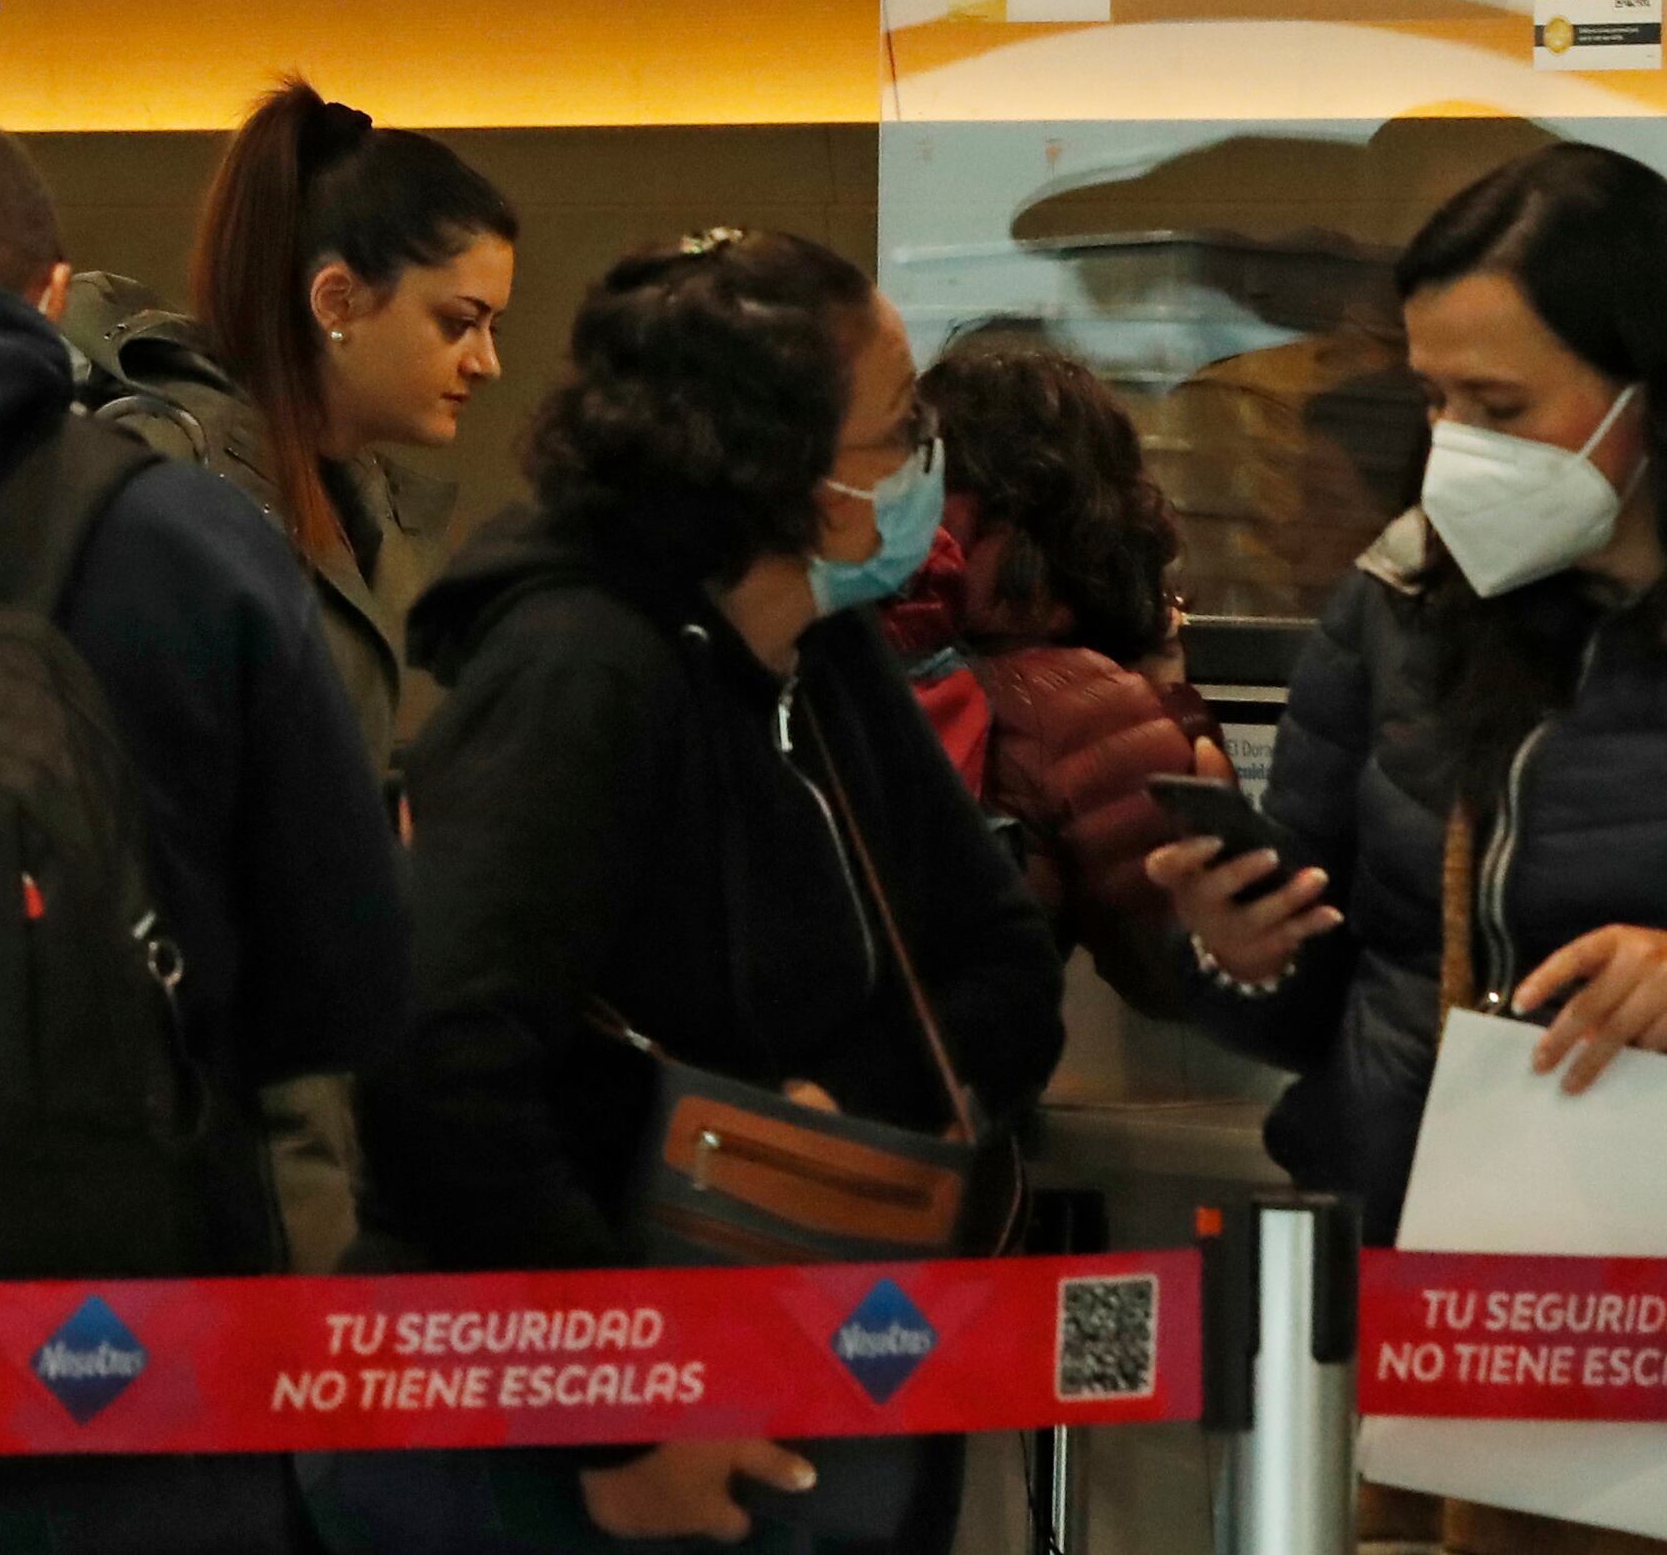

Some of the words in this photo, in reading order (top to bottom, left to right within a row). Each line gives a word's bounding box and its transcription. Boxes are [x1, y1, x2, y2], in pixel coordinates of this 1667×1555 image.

[1424, 1290, 1475, 1328] TU
[327, 1314, 386, 1354] TU
[397, 1309, 662, 1354] SEGURIDAD
[274, 1372, 345, 1408] NO
[362, 1367, 491, 1407] TIENE
[499, 1362, 703, 1406] ESCALAS
[1379, 1344, 1444, 1380] NO
[1456, 1344, 1574, 1383] TIENE
[1584, 1348, 1667, 1385] ESC
